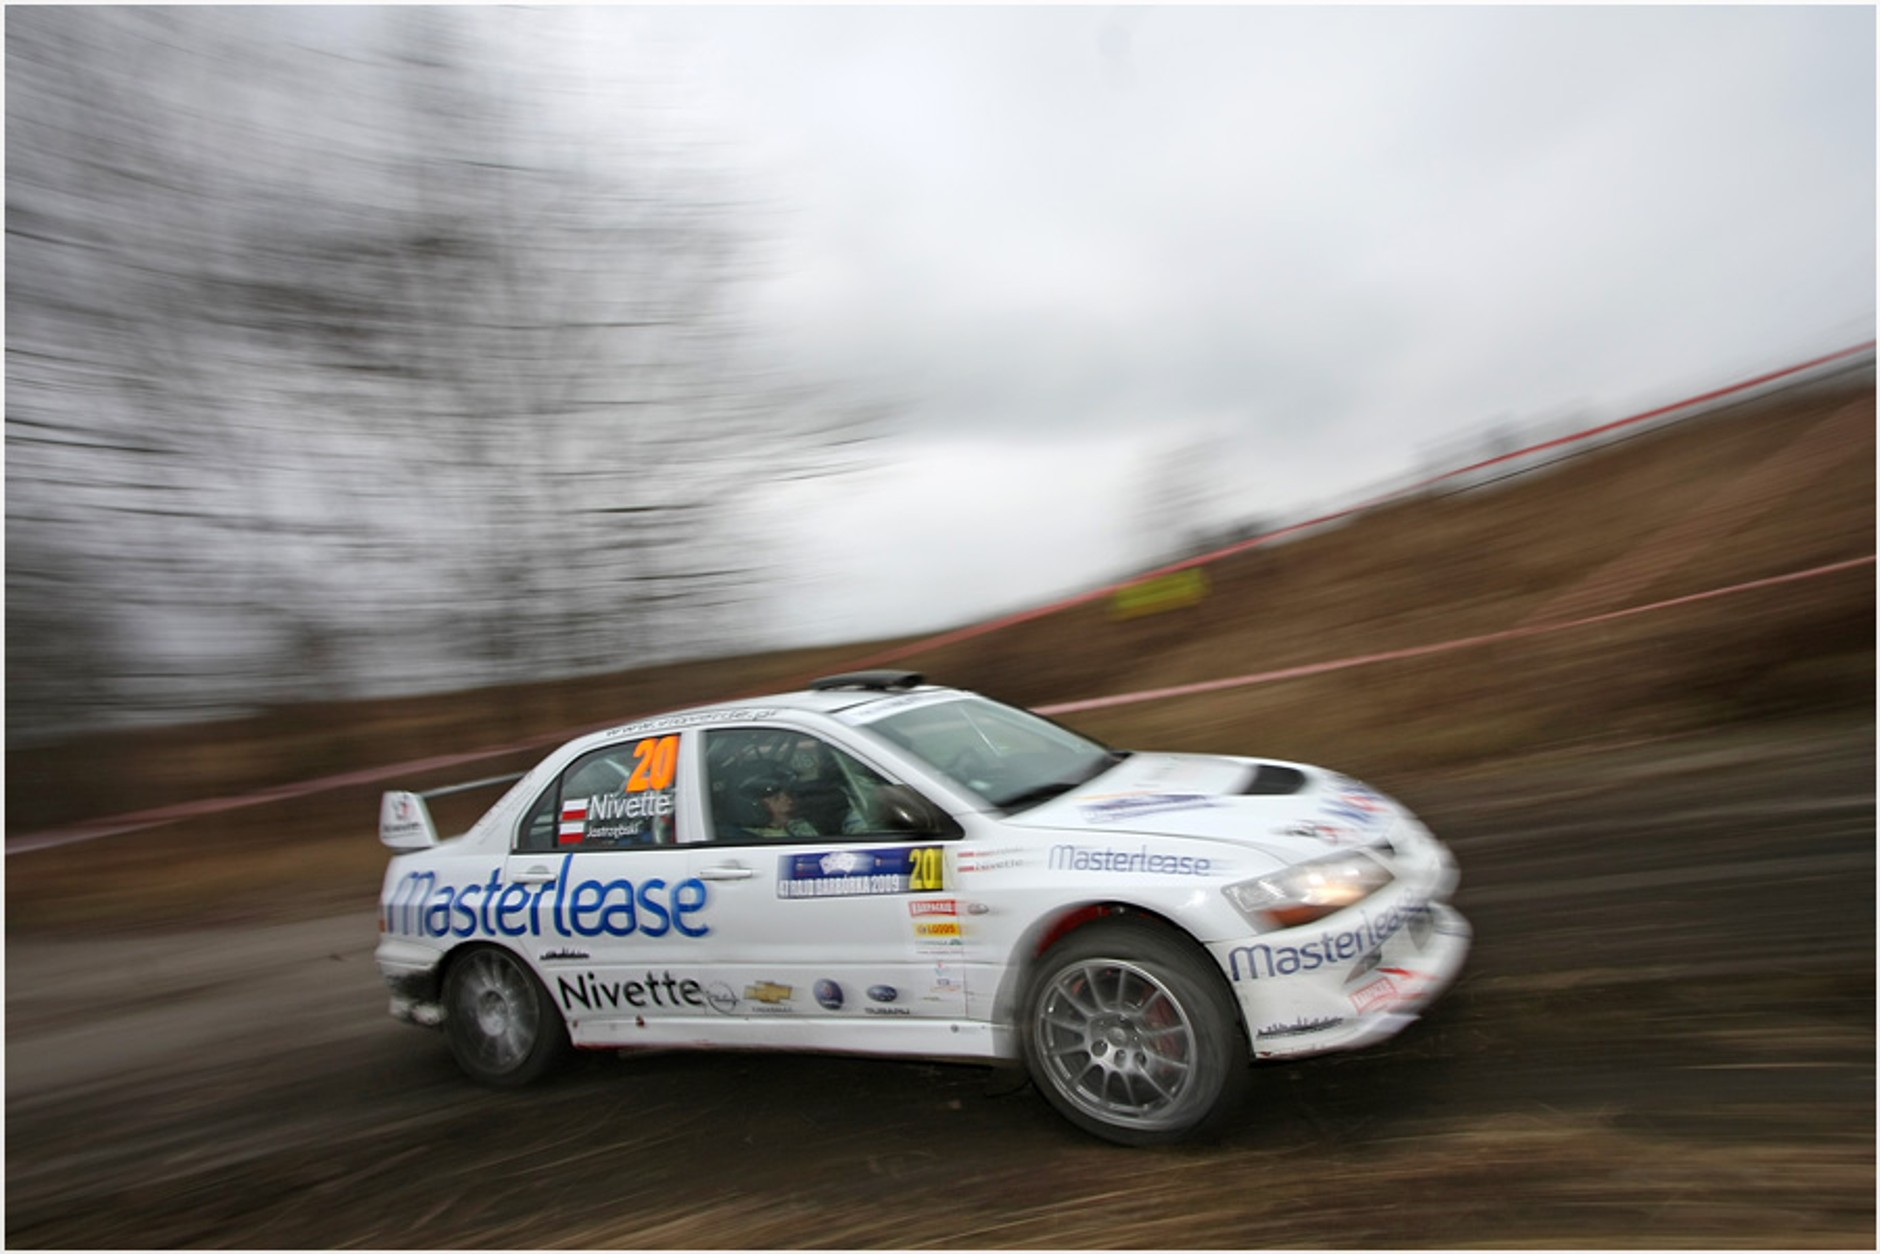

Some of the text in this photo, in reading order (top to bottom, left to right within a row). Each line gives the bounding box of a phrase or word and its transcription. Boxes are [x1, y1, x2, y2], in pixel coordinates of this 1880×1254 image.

[625, 734, 681, 793] 20
[588, 790, 673, 820] Nivette
[908, 848, 937, 890] 20
[1049, 844, 1212, 877] Masterlease
[382, 852, 711, 938] Masterlease
[556, 969, 703, 1011] Nivette
